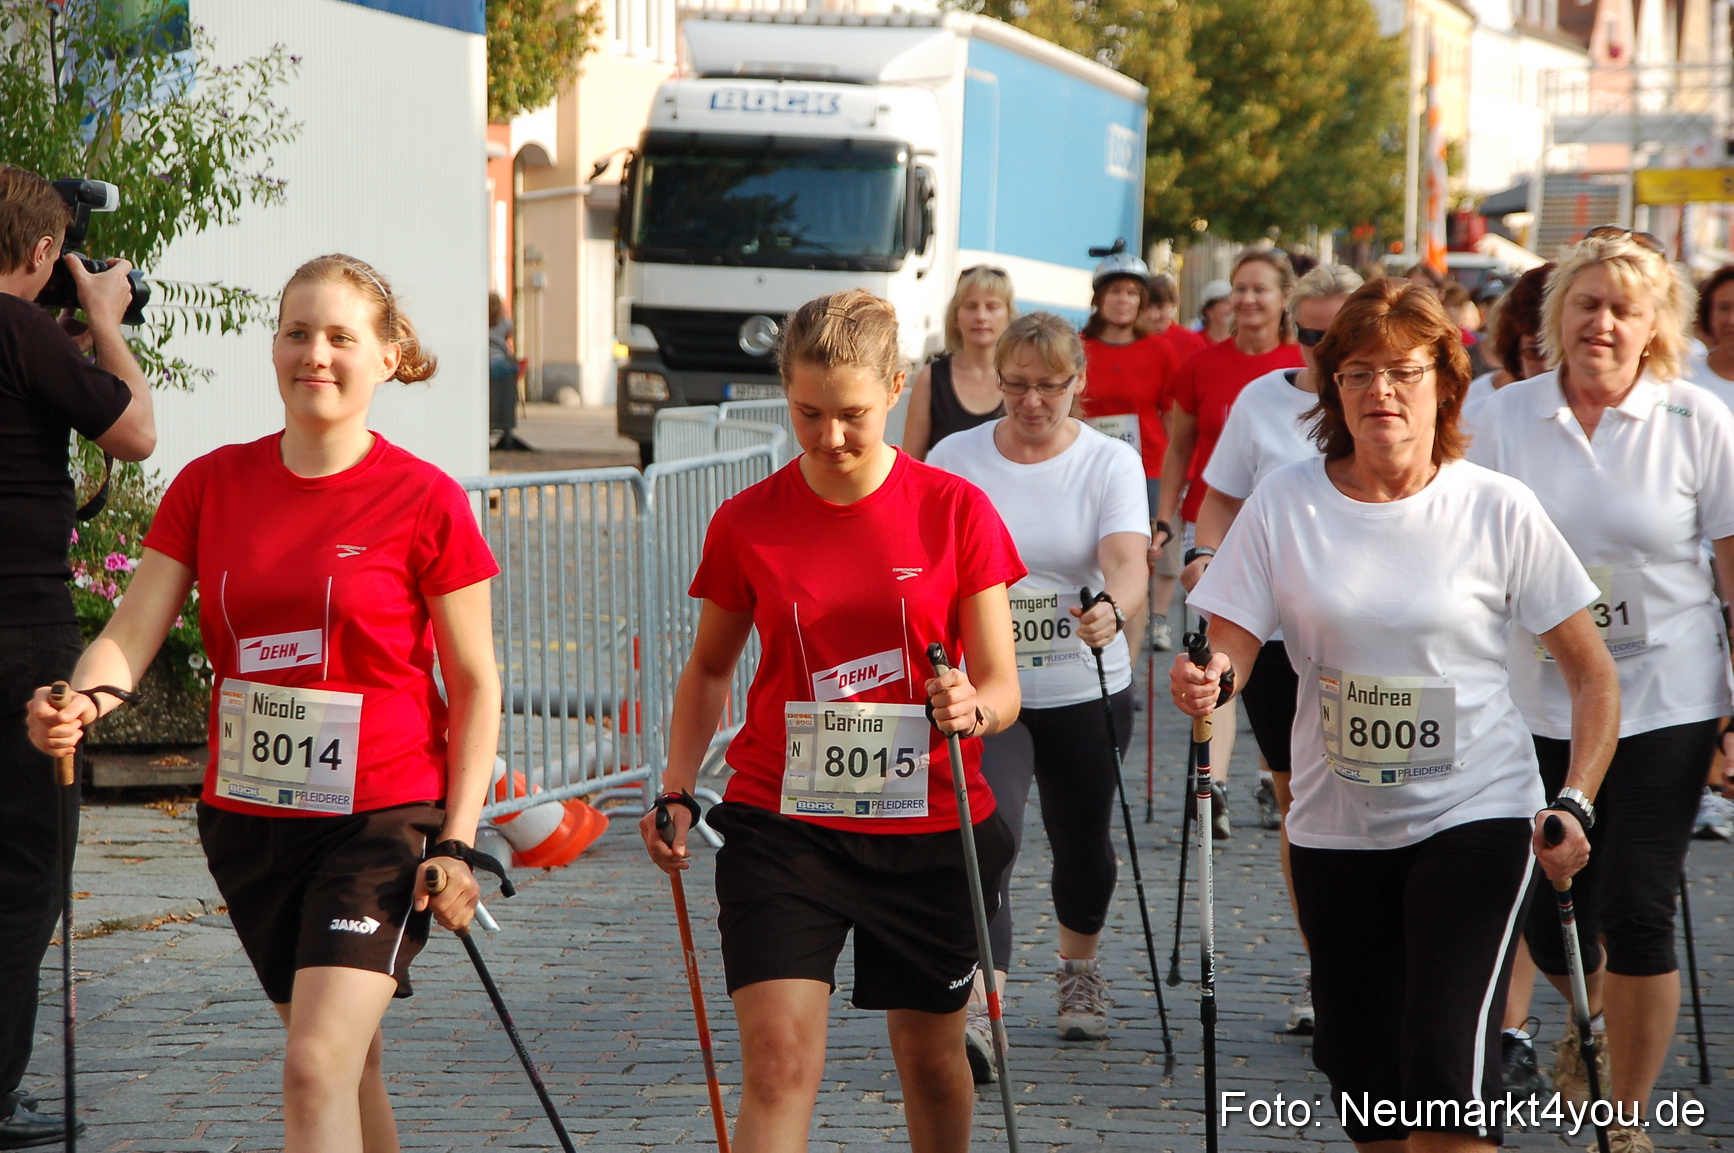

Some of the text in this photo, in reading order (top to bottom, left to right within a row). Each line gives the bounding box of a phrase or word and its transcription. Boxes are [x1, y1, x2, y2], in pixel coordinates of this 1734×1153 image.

[710, 87, 841, 114] BOCK
[1009, 593, 1058, 613] rmgard
[259, 642, 299, 661] DEHN
[838, 664, 879, 689] DEHN
[1347, 680, 1412, 707] Andrea
[252, 691, 306, 720] Nicole
[1323, 705, 1330, 722] N
[224, 721, 233, 739] N
[824, 709, 884, 733] Carina
[1349, 716, 1441, 750] 8008
[251, 730, 342, 771] 8014
[791, 741, 801, 758] N
[824, 745, 916, 779] 8015
[1397, 763, 1453, 778] PFLEIDERER
[294, 790, 350, 806] PFLEIDERER
[796, 801, 835, 810] BOCK
[871, 799, 925, 810] PFLEIDERER
[329, 918, 370, 934] JAKO
